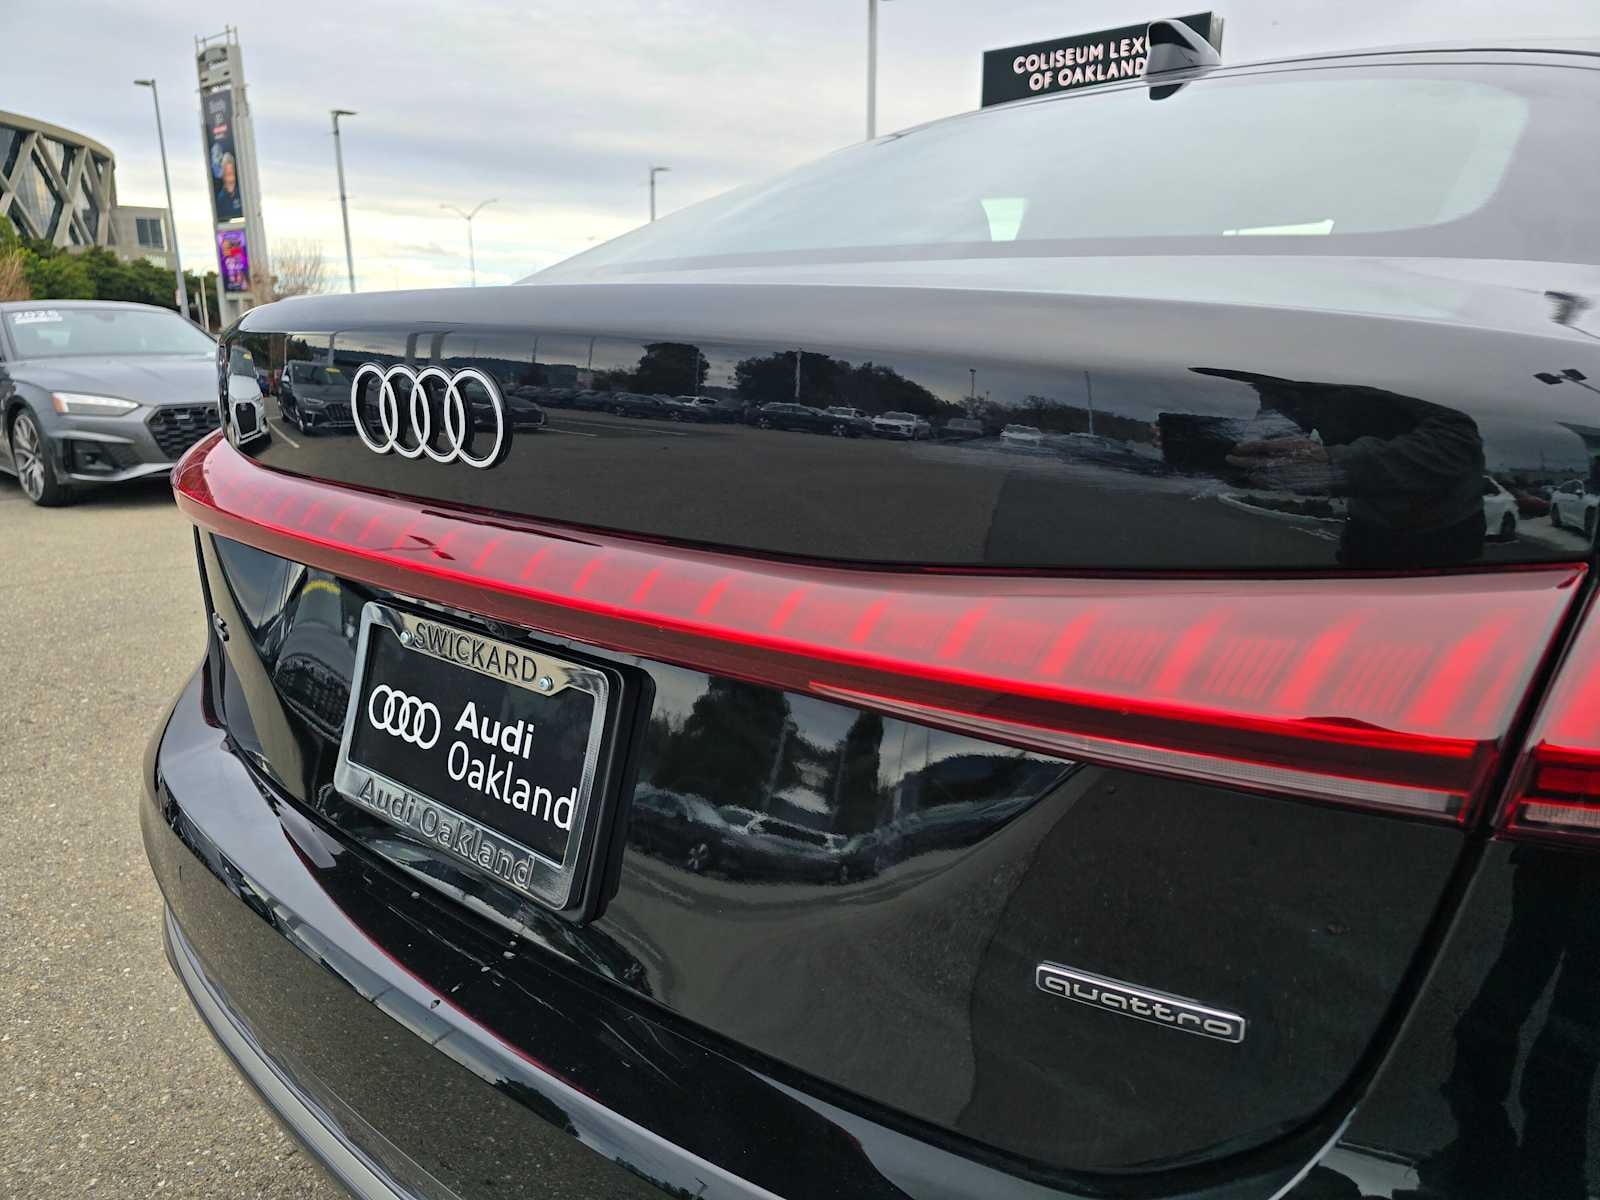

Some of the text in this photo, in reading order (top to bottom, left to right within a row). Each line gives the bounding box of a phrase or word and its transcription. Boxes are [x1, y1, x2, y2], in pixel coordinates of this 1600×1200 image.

[1013, 36, 1151, 74] COLISEUM LEX
[1029, 57, 1147, 91] OF OAKLAND
[415, 622, 538, 684] SWICKARD
[454, 701, 535, 759] Audi
[447, 741, 578, 831] Oakland
[358, 776, 535, 889] Audi Oakland
[1045, 976, 1232, 1035] quattro
